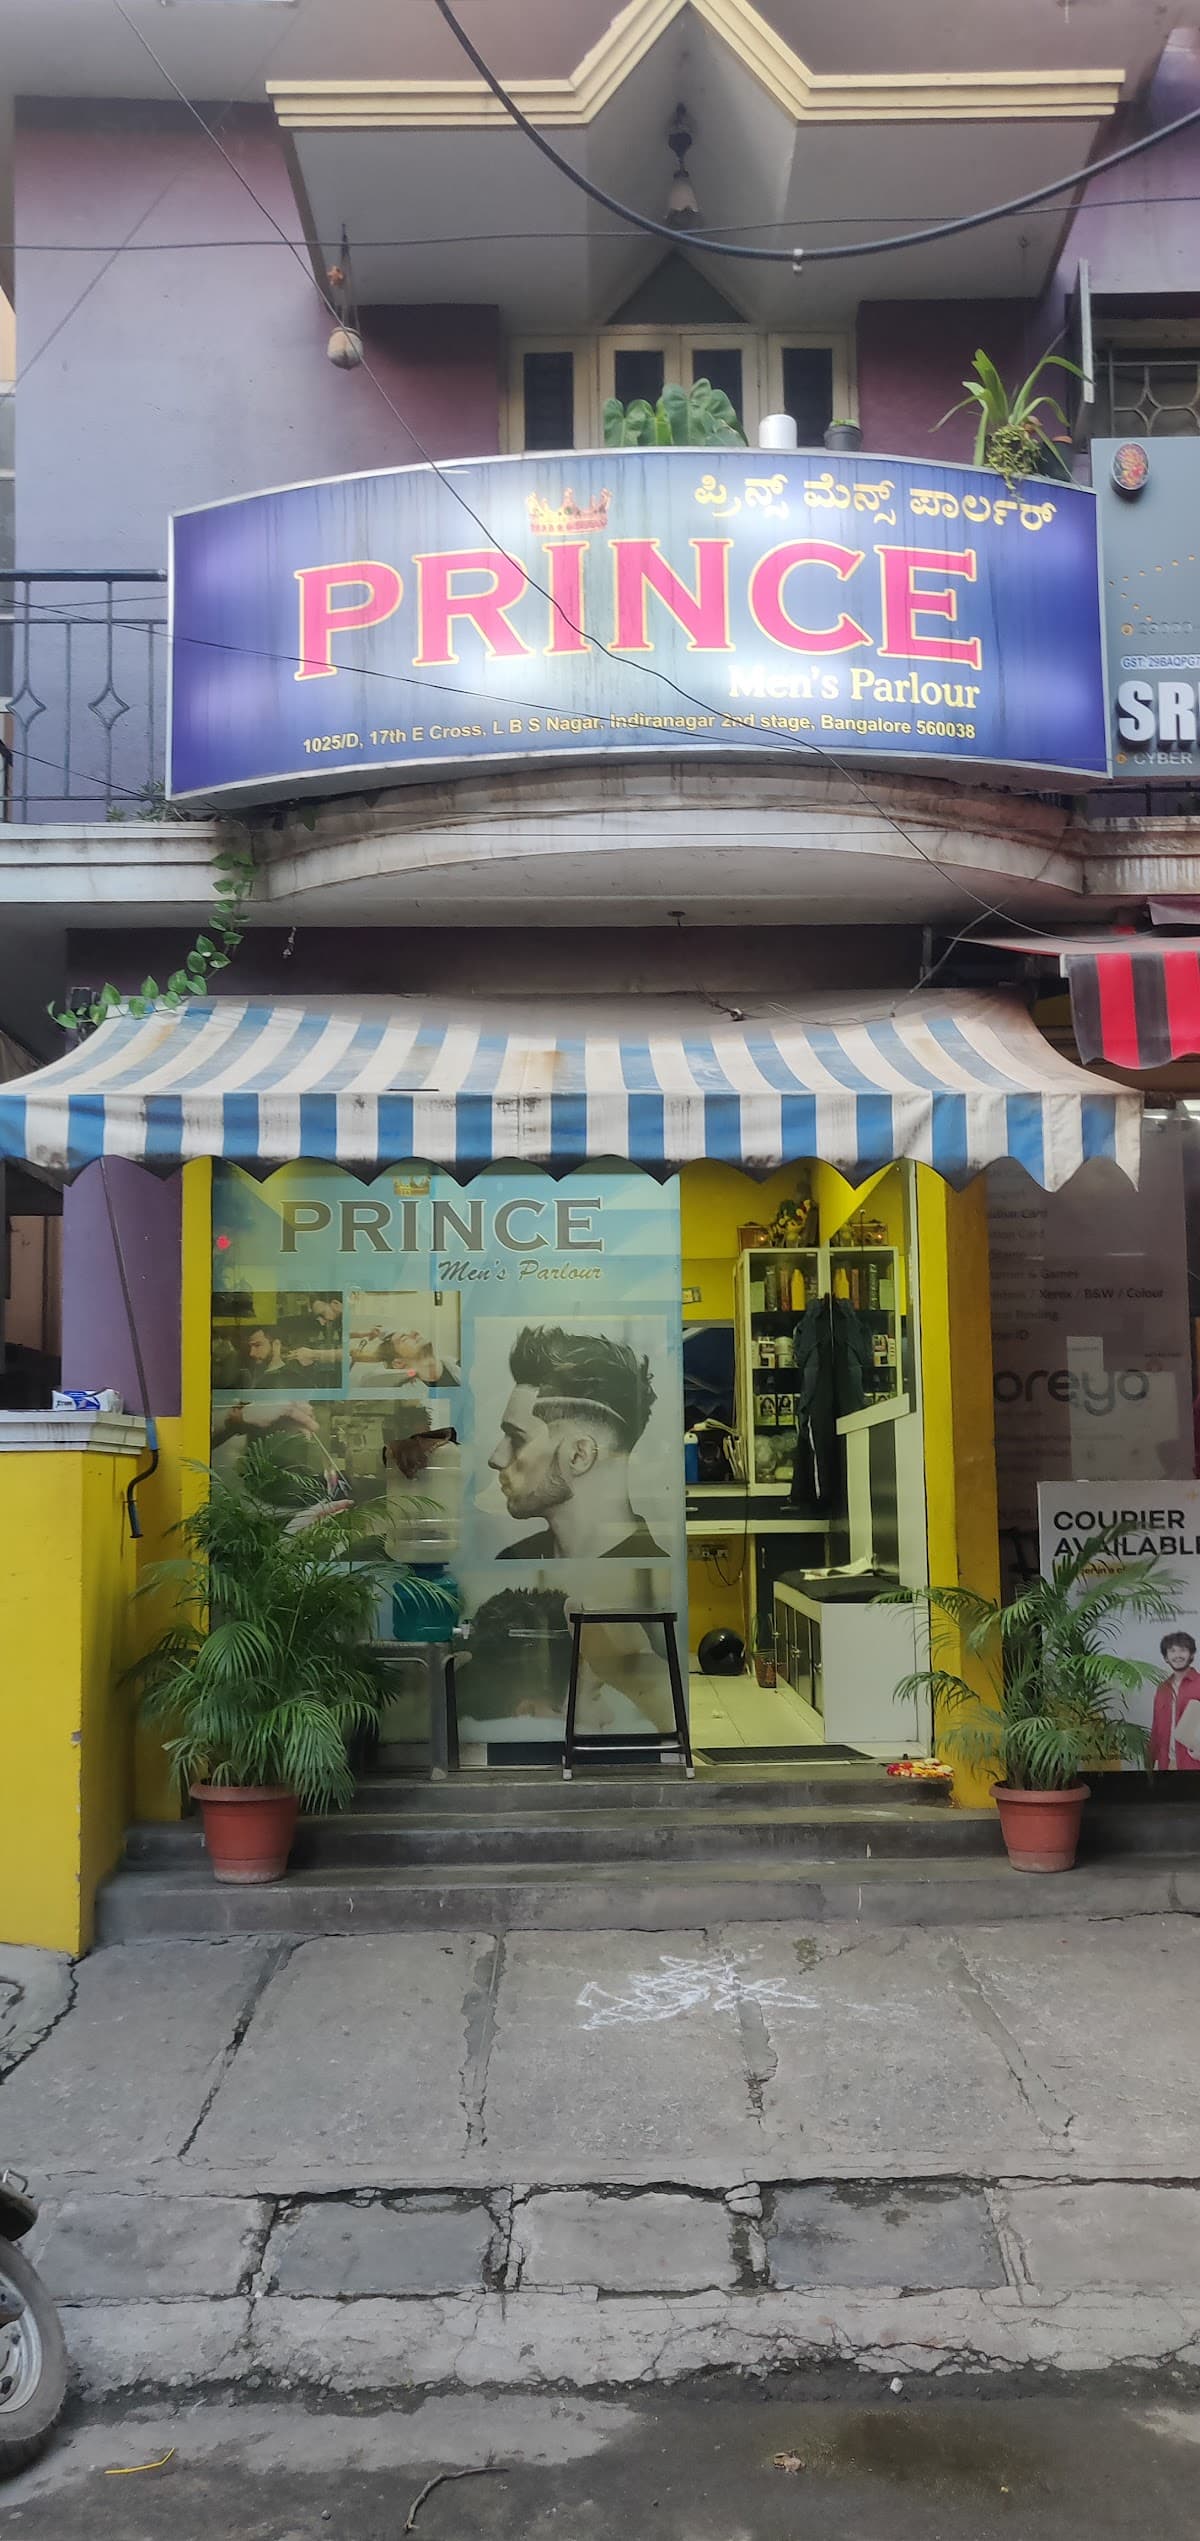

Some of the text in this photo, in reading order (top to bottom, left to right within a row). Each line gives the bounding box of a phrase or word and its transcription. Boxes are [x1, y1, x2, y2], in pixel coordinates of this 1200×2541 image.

[803, 473, 897, 526] ಮೆನ್ಸ್
[293, 537, 983, 681] PRINCE
[728, 664, 981, 709] Men's Parlour
[1118, 680, 1200, 741] SR
[303, 732, 364, 754] 1025/D,
[370, 728, 407, 746] 17th
[412, 726, 424, 741] E
[493, 720, 505, 735] L
[509, 718, 523, 733] B
[528, 717, 541, 733] S
[610, 712, 716, 731] Indiranagar
[721, 712, 755, 728] 2nd
[760, 713, 816, 732] stage,
[821, 714, 911, 735] Bangalore
[916, 719, 976, 740] 560038
[1133, 751, 1193, 765] CYBER
[279, 1196, 604, 1253] PRINCE
[437, 1259, 602, 1281] Men's Parlour
